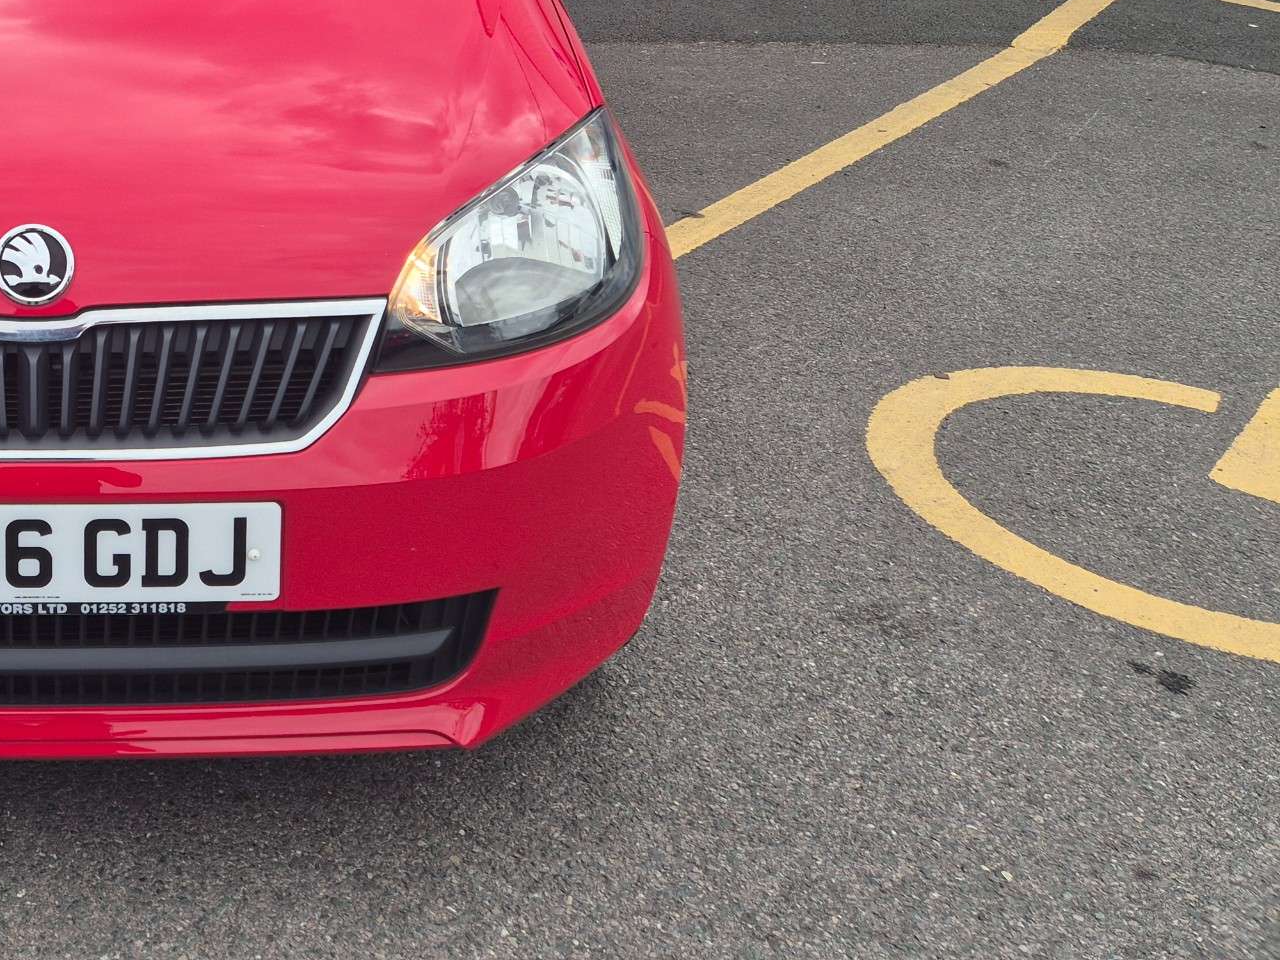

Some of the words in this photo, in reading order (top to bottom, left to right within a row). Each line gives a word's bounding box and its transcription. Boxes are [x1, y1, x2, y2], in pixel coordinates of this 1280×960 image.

[83, 517, 248, 588] GDJ
[38, 603, 68, 614] LTD
[80, 603, 127, 614] 01252
[131, 602, 187, 614] 311818
